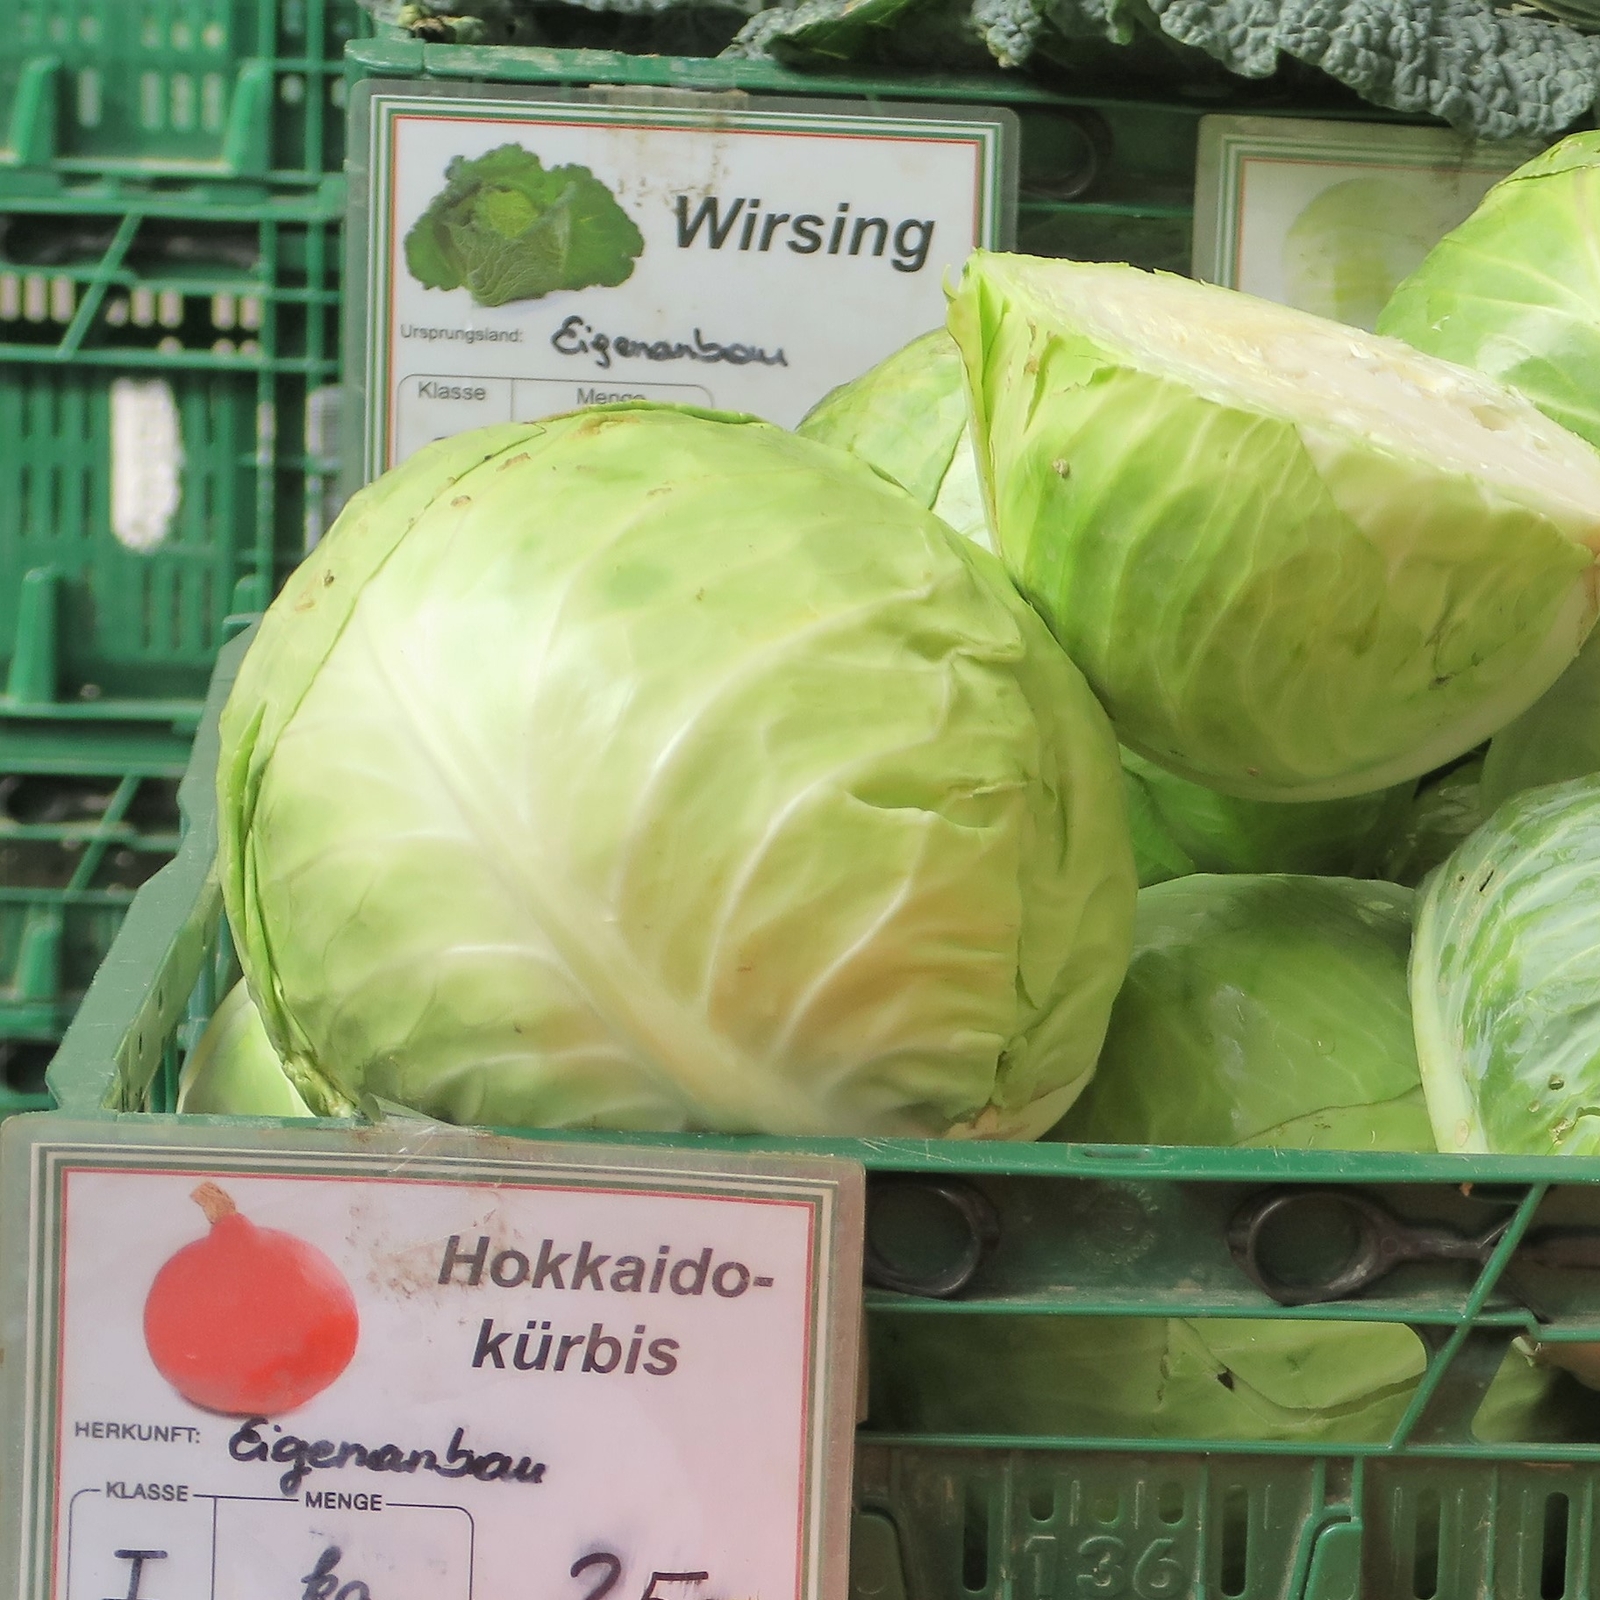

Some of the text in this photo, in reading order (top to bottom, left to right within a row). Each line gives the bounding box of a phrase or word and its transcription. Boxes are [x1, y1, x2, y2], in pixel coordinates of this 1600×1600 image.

[676, 195, 935, 272] Wirsing
[400, 322, 524, 344] Ursprungsland:
[418, 380, 487, 401] Klasse
[437, 1235, 775, 1298] Hokkaido-
[471, 1318, 681, 1376] kürbis
[75, 1417, 547, 1497] HERKUNFT: Eigenanbau
[105, 1481, 383, 1512] KLASSE MENGE
[1024, 1535, 1188, 1600] 136
